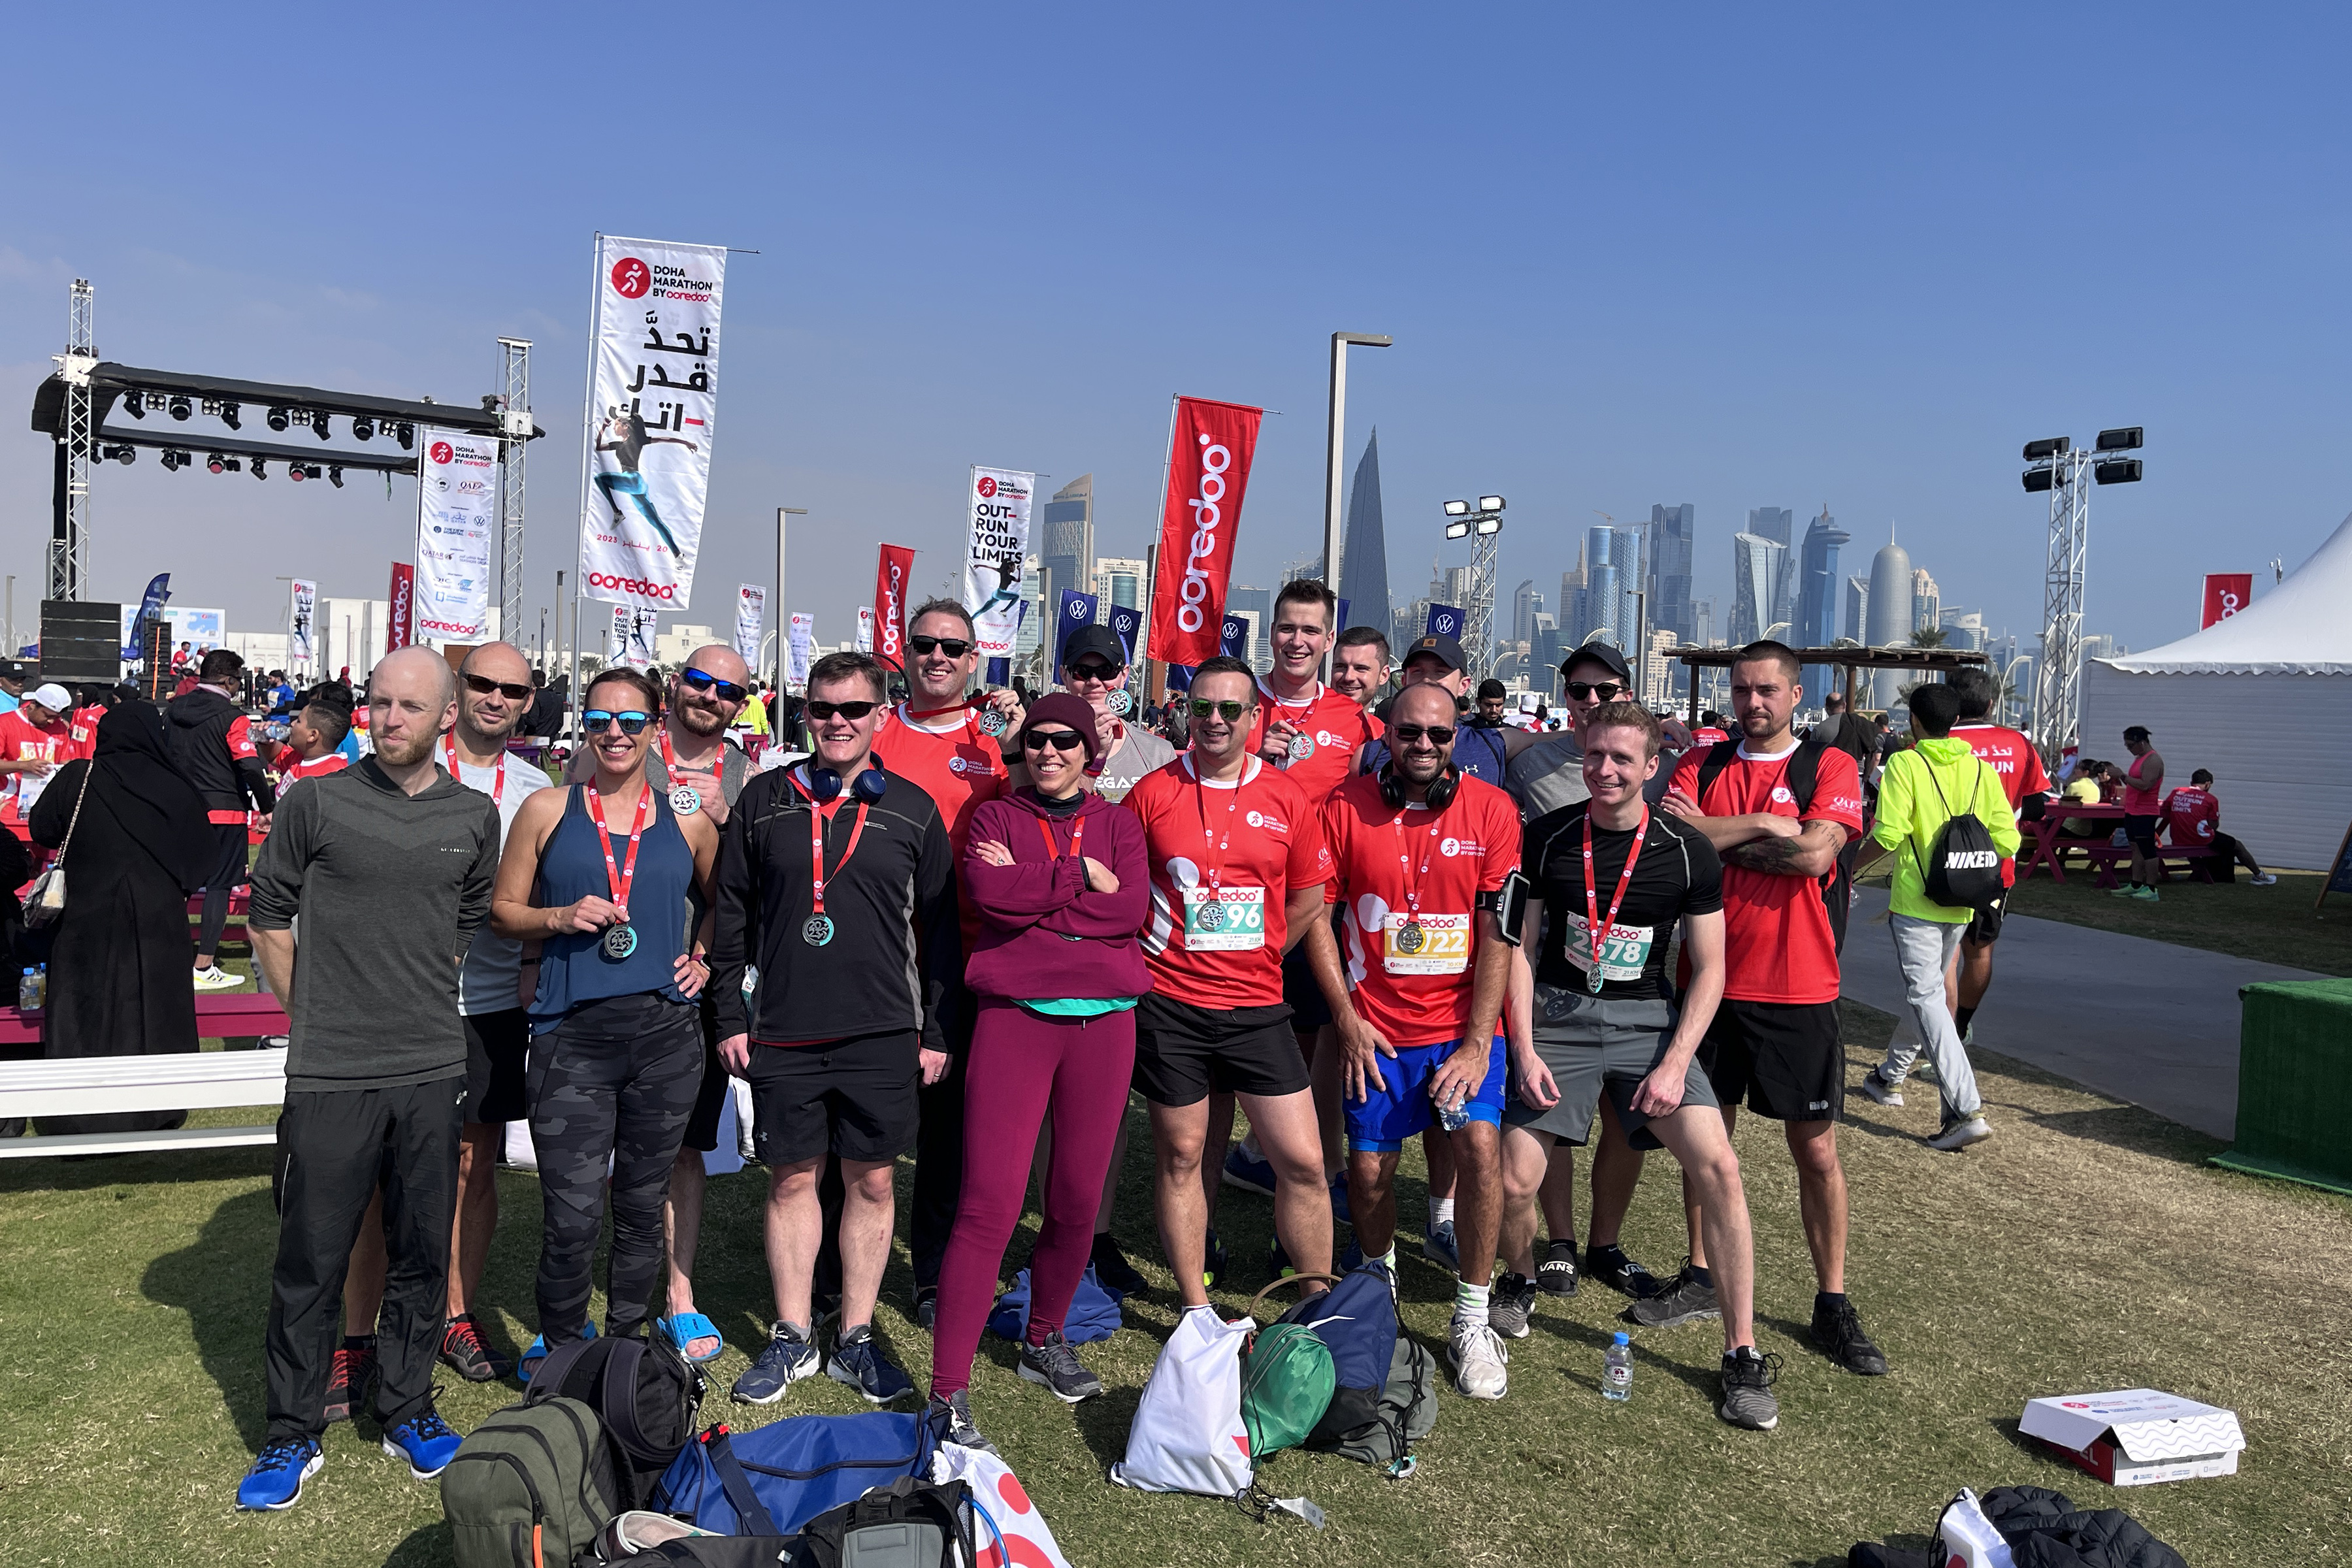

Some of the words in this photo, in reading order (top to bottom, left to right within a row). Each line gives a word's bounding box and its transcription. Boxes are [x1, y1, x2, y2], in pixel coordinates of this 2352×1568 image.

[654, 265, 685, 277] DOHA
[653, 276, 713, 291] MARATHON
[653, 288, 666, 297] BY
[666, 291, 711, 302] ooredoo
[455, 452, 492, 461] MARATHON
[976, 517, 1008, 534] RUN
[596, 534, 617, 544] 2023
[975, 531, 1018, 549] YOUR
[1177, 434, 1231, 633] ooredoo
[973, 546, 1022, 564] LIMITS
[589, 572, 678, 599] ooredoo
[883, 561, 901, 655] ooredoo
[421, 619, 478, 634] ooredoo
[976, 640, 1011, 650] redoo
[1094, 776, 1142, 789] EGAS
[2174, 796, 2202, 805] OUTRUN
[1264, 819, 1288, 829] MARATHON
[1197, 889, 1258, 902] oedoo
[1397, 916, 1458, 928] oedoo
[1539, 1261, 1575, 1275] VANS
